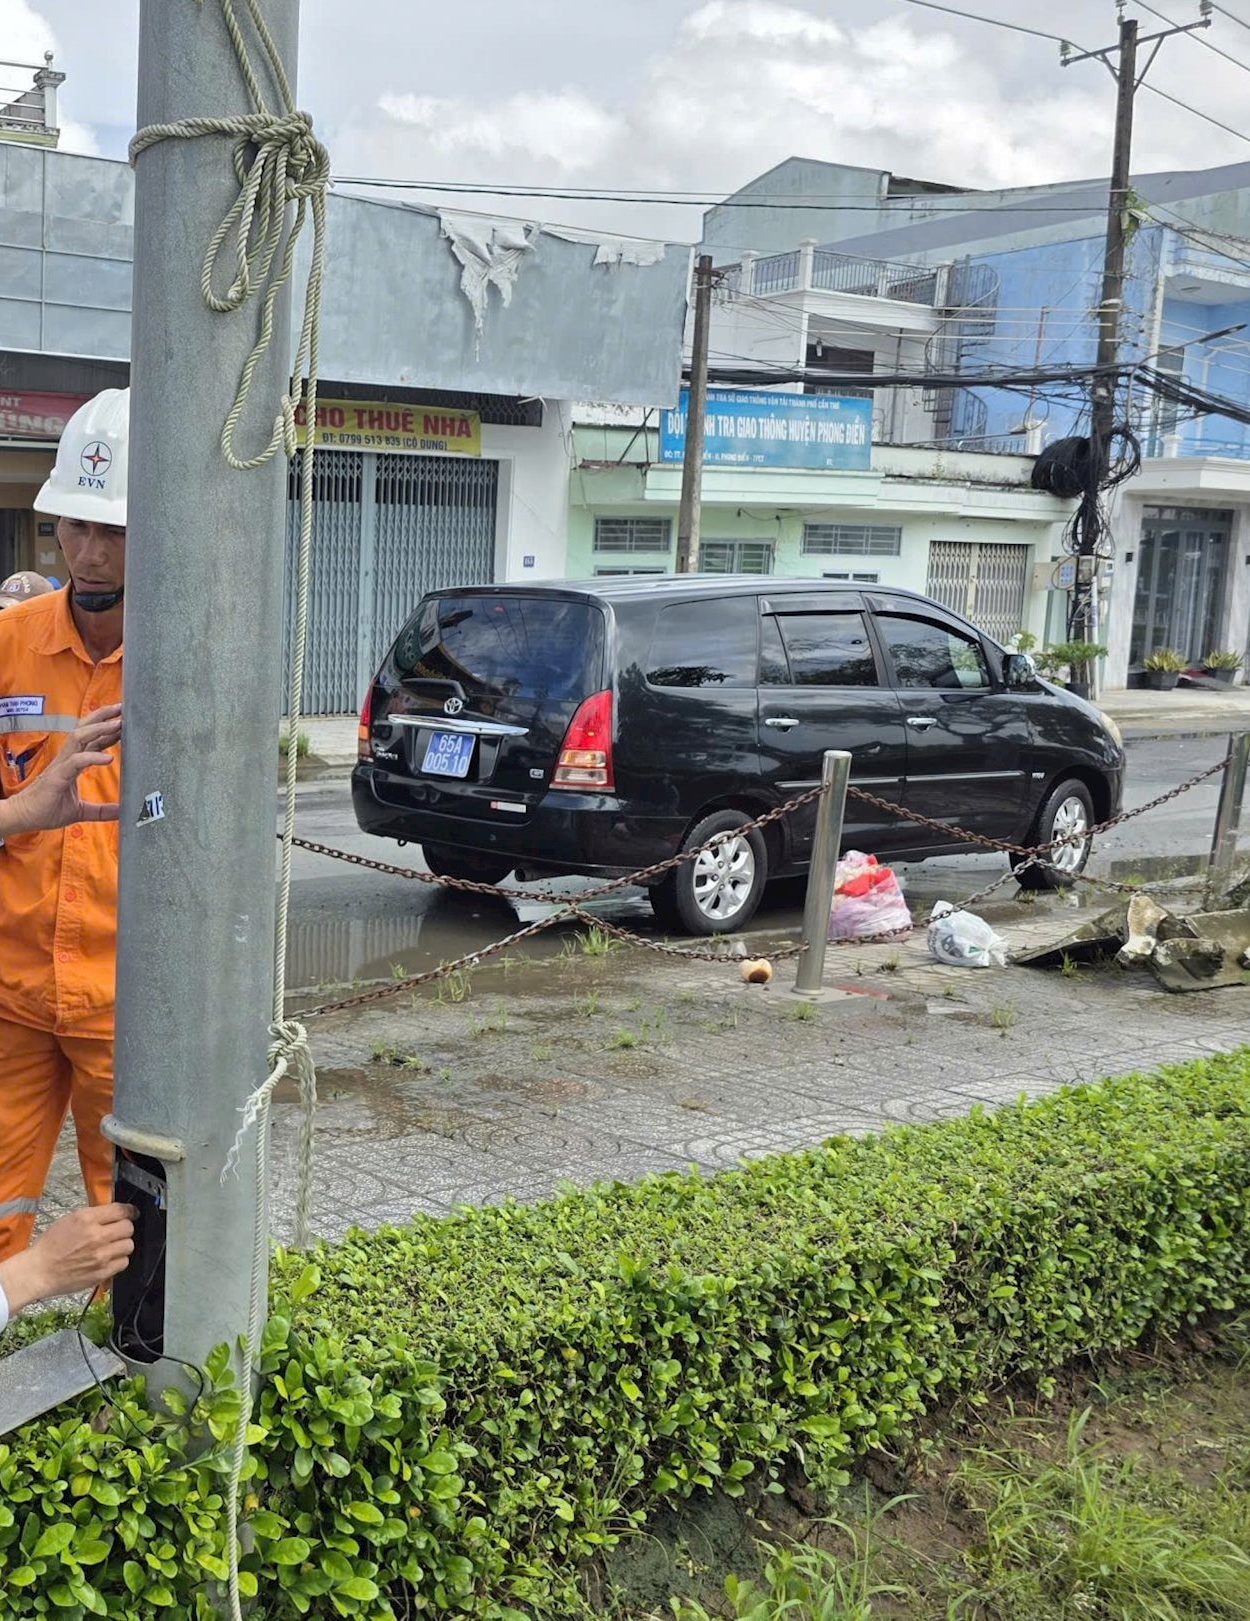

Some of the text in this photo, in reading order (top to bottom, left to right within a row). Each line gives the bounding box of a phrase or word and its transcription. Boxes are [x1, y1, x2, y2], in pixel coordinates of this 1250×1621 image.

[294, 404, 472, 438] CHO THUÊ NHÀ
[717, 415, 735, 438] TRA
[737, 416, 757, 439] GIAO
[758, 412, 787, 440] THÔNG
[788, 415, 816, 446] HUYỆN
[817, 420, 845, 444] PHONG
[339, 433, 362, 444] 0799
[365, 434, 382, 445] 513
[78, 476, 106, 490] EVN
[438, 733, 463, 753] 65A
